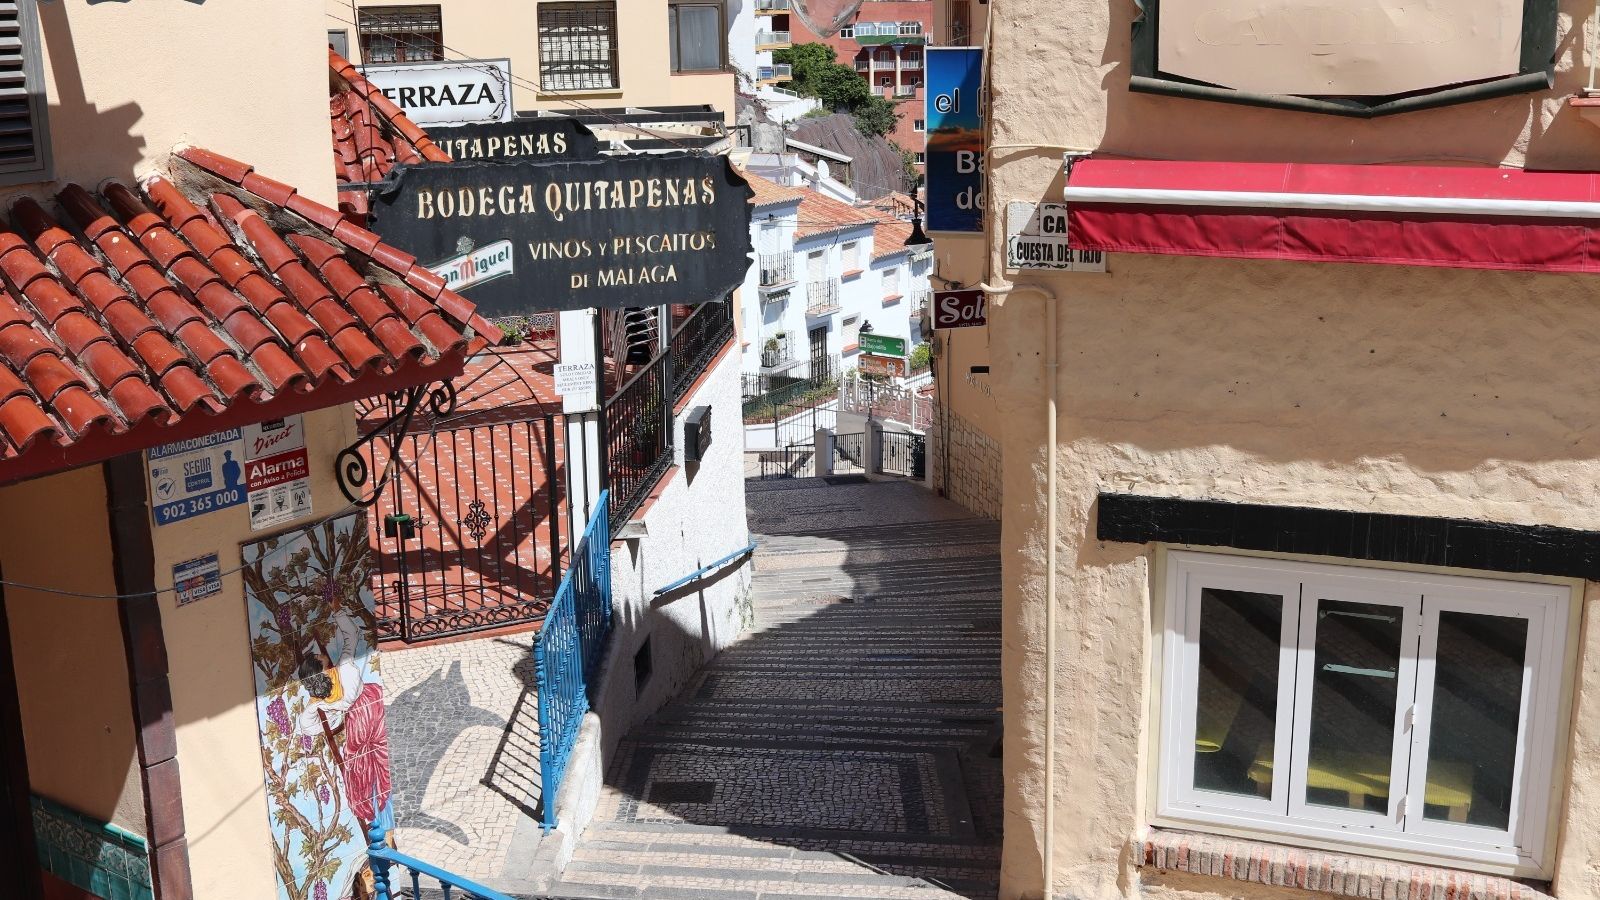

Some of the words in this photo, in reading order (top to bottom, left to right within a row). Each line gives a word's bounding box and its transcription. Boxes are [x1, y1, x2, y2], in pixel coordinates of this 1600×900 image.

[382, 82, 497, 109] ERRAZA
[934, 87, 960, 114] el
[434, 132, 567, 160] ITAPENAS
[417, 184, 537, 219] BODEGA
[545, 176, 716, 222] QUITAPENAS
[528, 241, 592, 261] VINOS
[613, 232, 716, 255] PESCAITOS
[1016, 241, 1054, 262] CUESTA
[1057, 243, 1075, 263] DEL
[459, 245, 509, 282] Miguel
[939, 294, 986, 324] Sol
[558, 364, 595, 372] TERRAZA
[254, 423, 296, 454] Direct
[183, 456, 212, 477] SEGUR
[250, 455, 305, 480] Alarma
[263, 477, 280, 485] Aviso
[162, 503, 187, 521] 902
[190, 495, 212, 513] 365
[216, 489, 239, 506] 000
